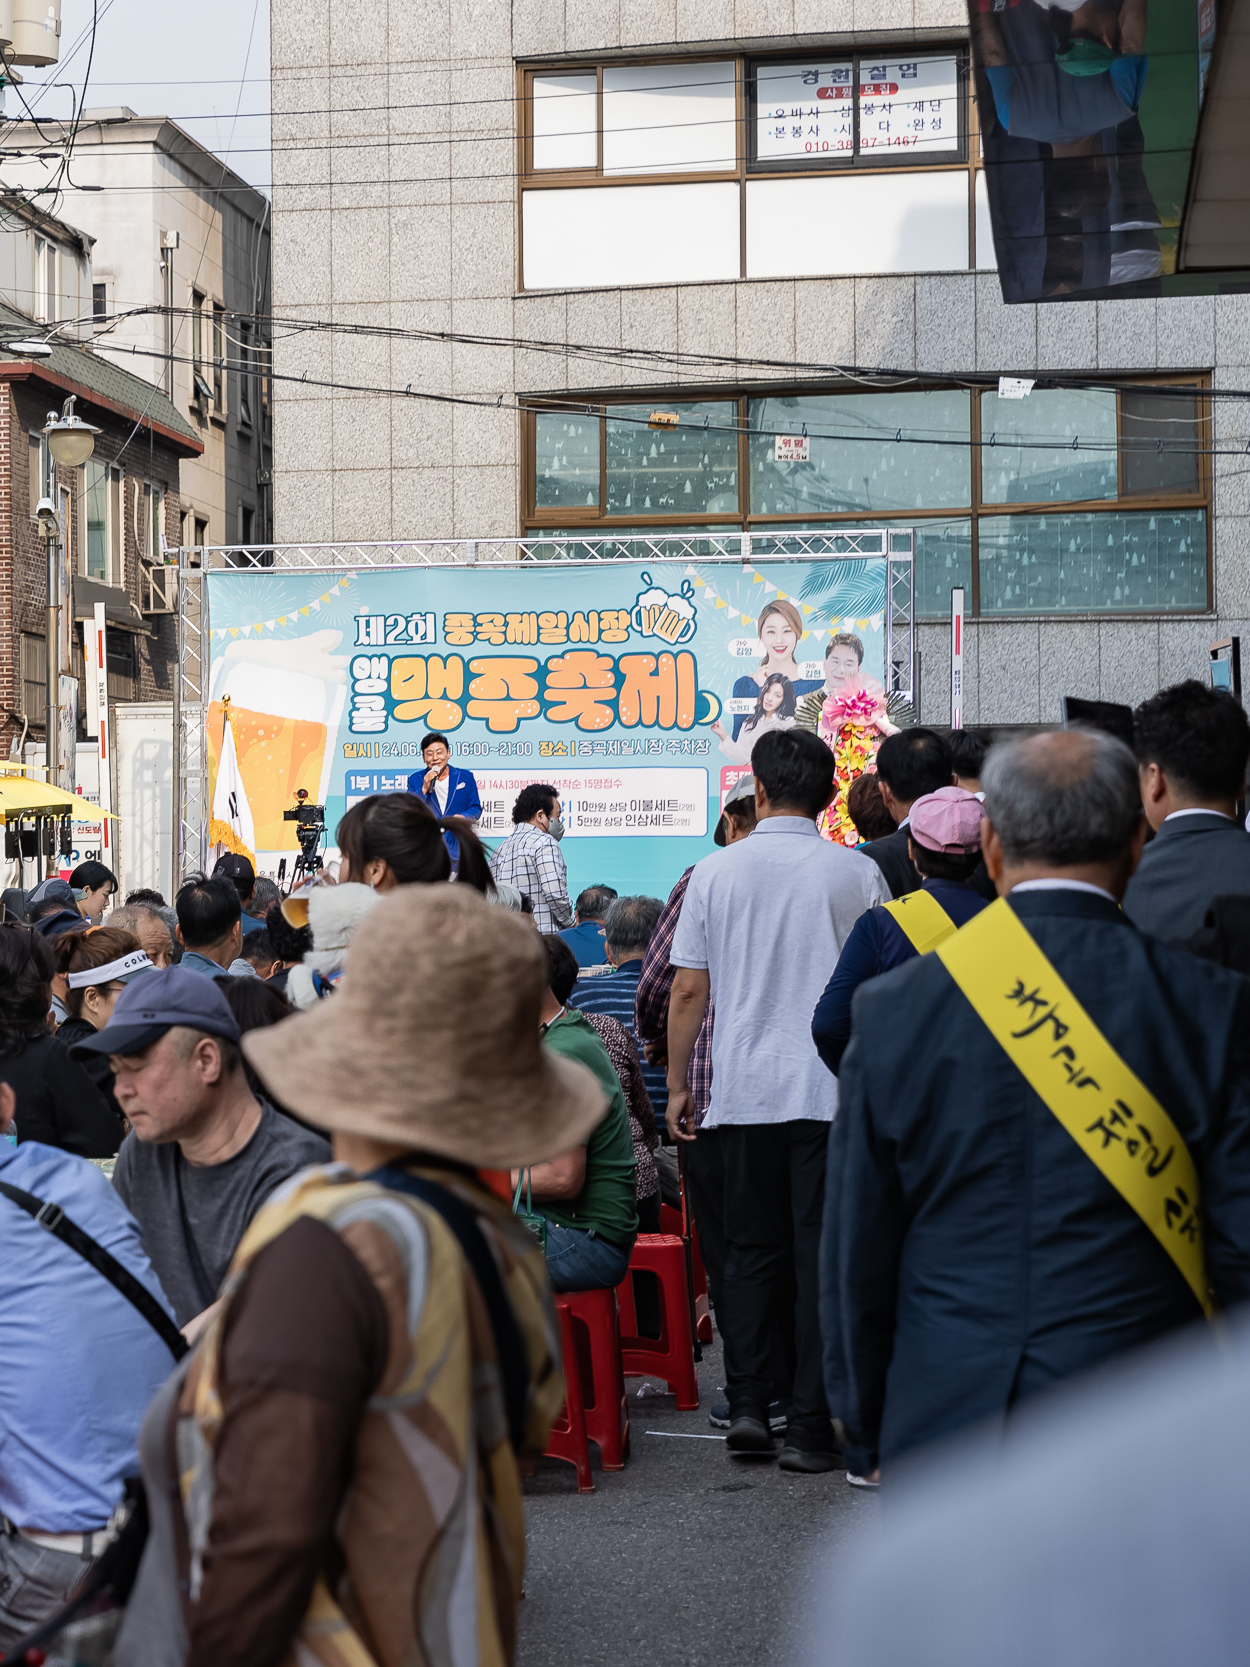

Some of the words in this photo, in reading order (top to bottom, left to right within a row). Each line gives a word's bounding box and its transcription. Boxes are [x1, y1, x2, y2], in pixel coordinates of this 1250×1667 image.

[825, 87, 852, 98] 사원
[863, 84, 890, 95] 모집
[912, 99, 942, 113] 재단
[912, 118, 942, 132] 완성
[355, 613, 436, 646] 제2회
[444, 609, 631, 646] 중곡제일시장
[351, 654, 389, 732] 앵콜
[389, 650, 698, 733] 맥주축제
[343, 743, 371, 758] 일시
[455, 741, 532, 757] 16:00~21:00
[539, 740, 568, 757] 장소
[579, 739, 663, 756] 중곡제일시장
[666, 738, 711, 756] 주차장
[350, 775, 370, 791] 1부
[584, 778, 623, 790] 15명접수
[481, 800, 505, 814] 세트
[577, 800, 607, 813] 10만원
[609, 802, 627, 812] 상당
[577, 815, 601, 827] 5만원
[605, 817, 622, 827] 상당
